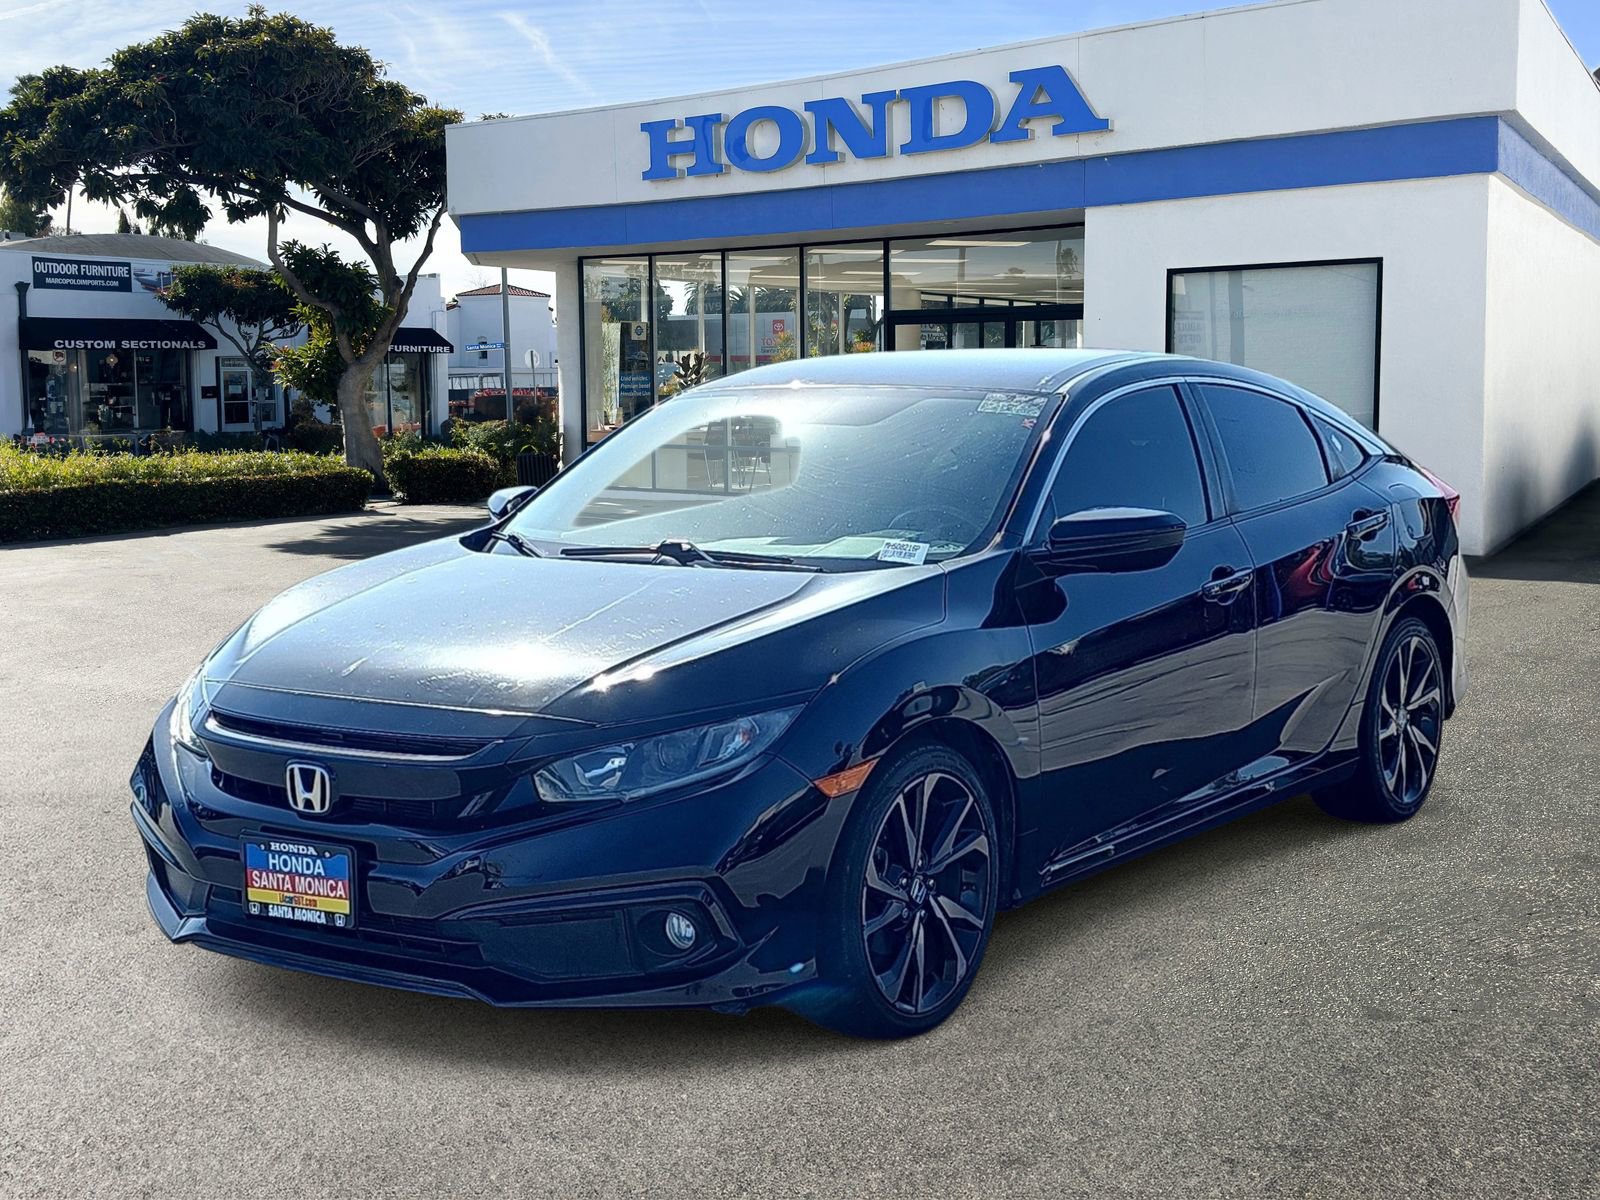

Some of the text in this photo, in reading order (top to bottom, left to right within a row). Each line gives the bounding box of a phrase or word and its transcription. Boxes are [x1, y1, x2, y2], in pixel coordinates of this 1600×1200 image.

[640, 65, 1111, 181] HONDA
[34, 261, 129, 278] OUTDOOR FURNITURE
[45, 277, 119, 287] MARCOPOLOIMPORTS.COM
[54, 339, 206, 349] CUSTOM SECTIONALS
[388, 344, 450, 353] FURNITURE
[270, 842, 317, 856] HONDA
[269, 853, 325, 876] HONDA
[252, 870, 346, 898] SANTA MONICA
[268, 904, 326, 924] SANTA MONICA
